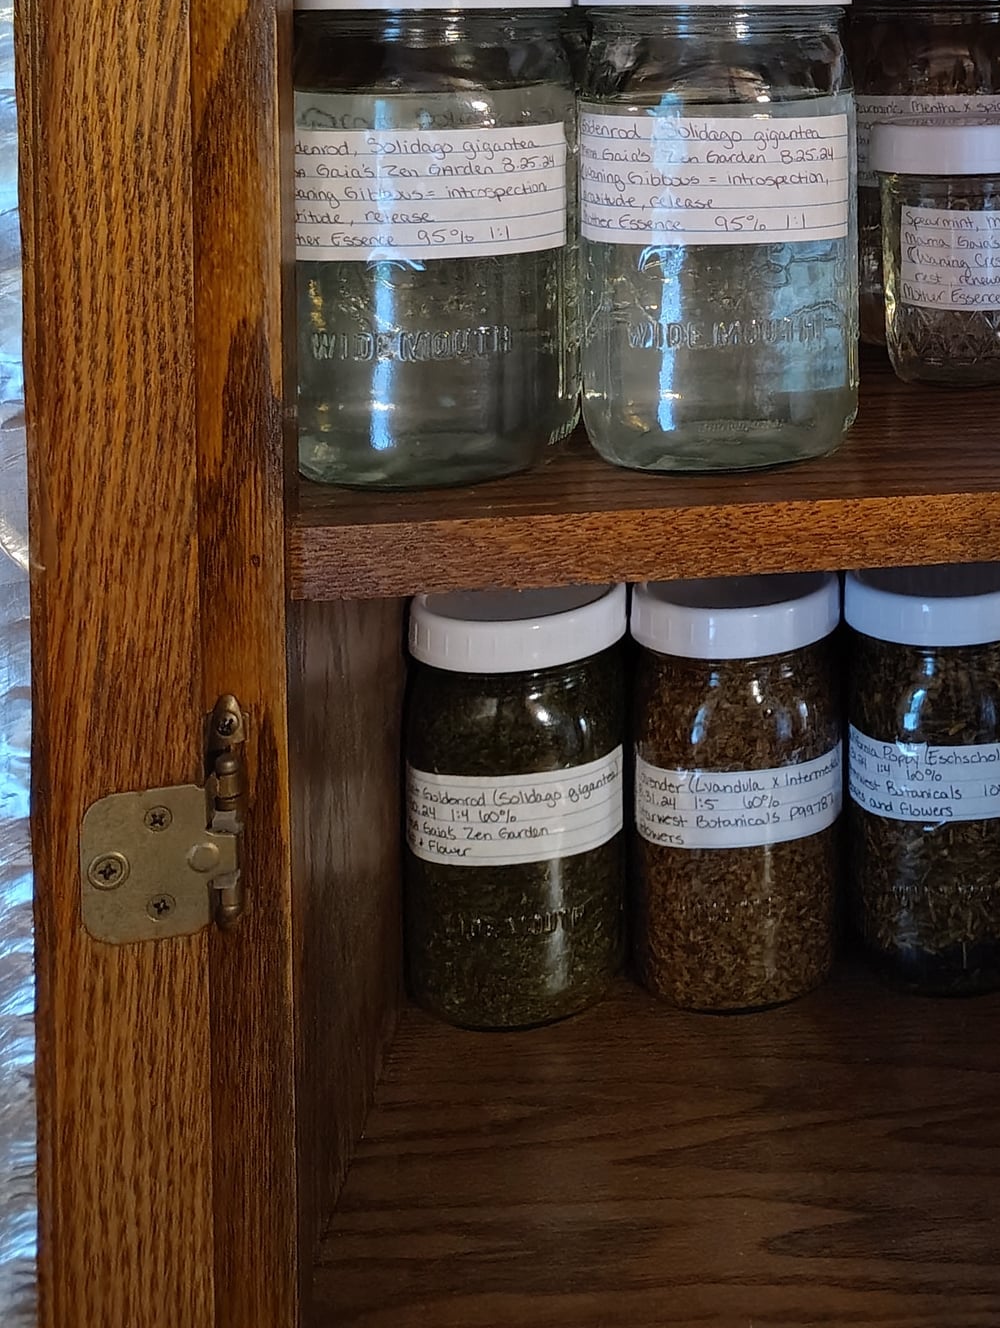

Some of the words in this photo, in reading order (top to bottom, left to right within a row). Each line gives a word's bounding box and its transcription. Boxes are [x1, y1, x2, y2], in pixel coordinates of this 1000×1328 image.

[754, 125, 826, 150] gigantea
[367, 137, 454, 160] Solidago
[463, 138, 540, 160] gigantea
[602, 148, 651, 163] Gaia's
[706, 150, 766, 164] Garden
[780, 147, 834, 165] 8.25.24
[316, 163, 375, 179] Gaia's
[386, 164, 419, 178] Zen
[627, 172, 700, 186] Gibbous
[727, 171, 829, 189] introspection,
[619, 214, 682, 231] Essence
[714, 214, 767, 232] 95%
[785, 213, 807, 230] 1:1
[906, 210, 979, 232] Spearmint,
[331, 231, 398, 247] Essence
[417, 227, 474, 246] 95%
[489, 225, 511, 240] 1:1
[957, 234, 1000, 249] Gaia's
[951, 287, 1000, 305] Essence
[877, 764, 891, 775] 1:4
[694, 798, 719, 810] 1:5
[870, 796, 893, 813] and
[451, 809, 469, 822] 1:4
[696, 813, 780, 830] Botanicals
[463, 826, 493, 841] Zen
[498, 825, 549, 841] Garden
[428, 841, 472, 857] Flower
